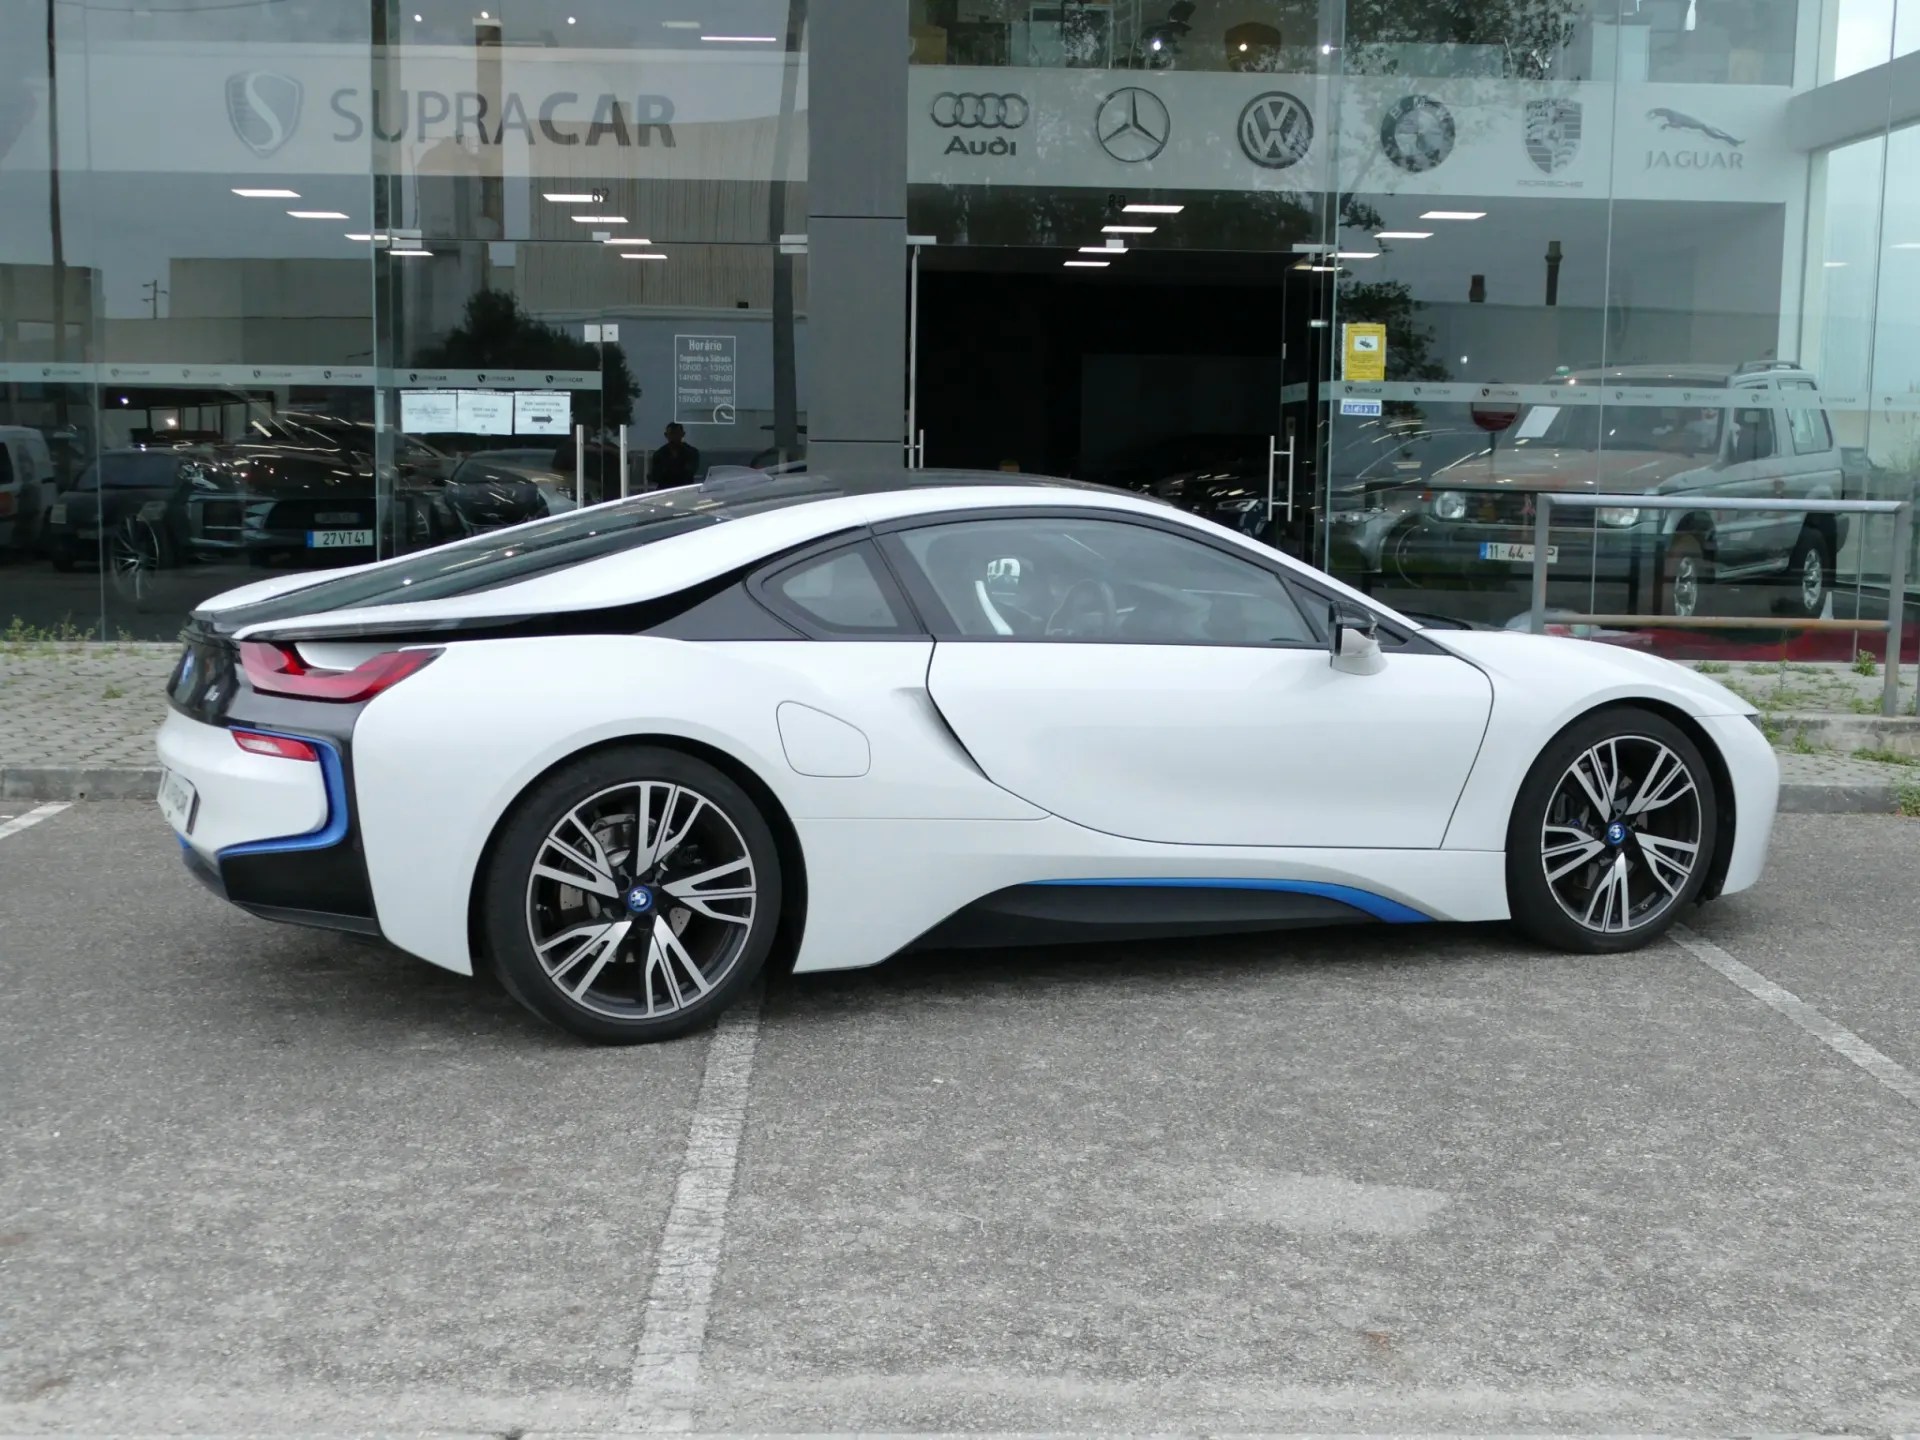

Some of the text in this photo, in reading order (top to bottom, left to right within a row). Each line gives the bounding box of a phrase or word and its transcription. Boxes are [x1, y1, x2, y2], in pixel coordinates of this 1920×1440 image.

[330, 88, 677, 148] SUPRACAR
[944, 136, 1017, 156] Audi
[1644, 150, 1744, 171] JAGUAR
[1516, 179, 1584, 188] PORSCHE
[688, 339, 722, 351] Horário
